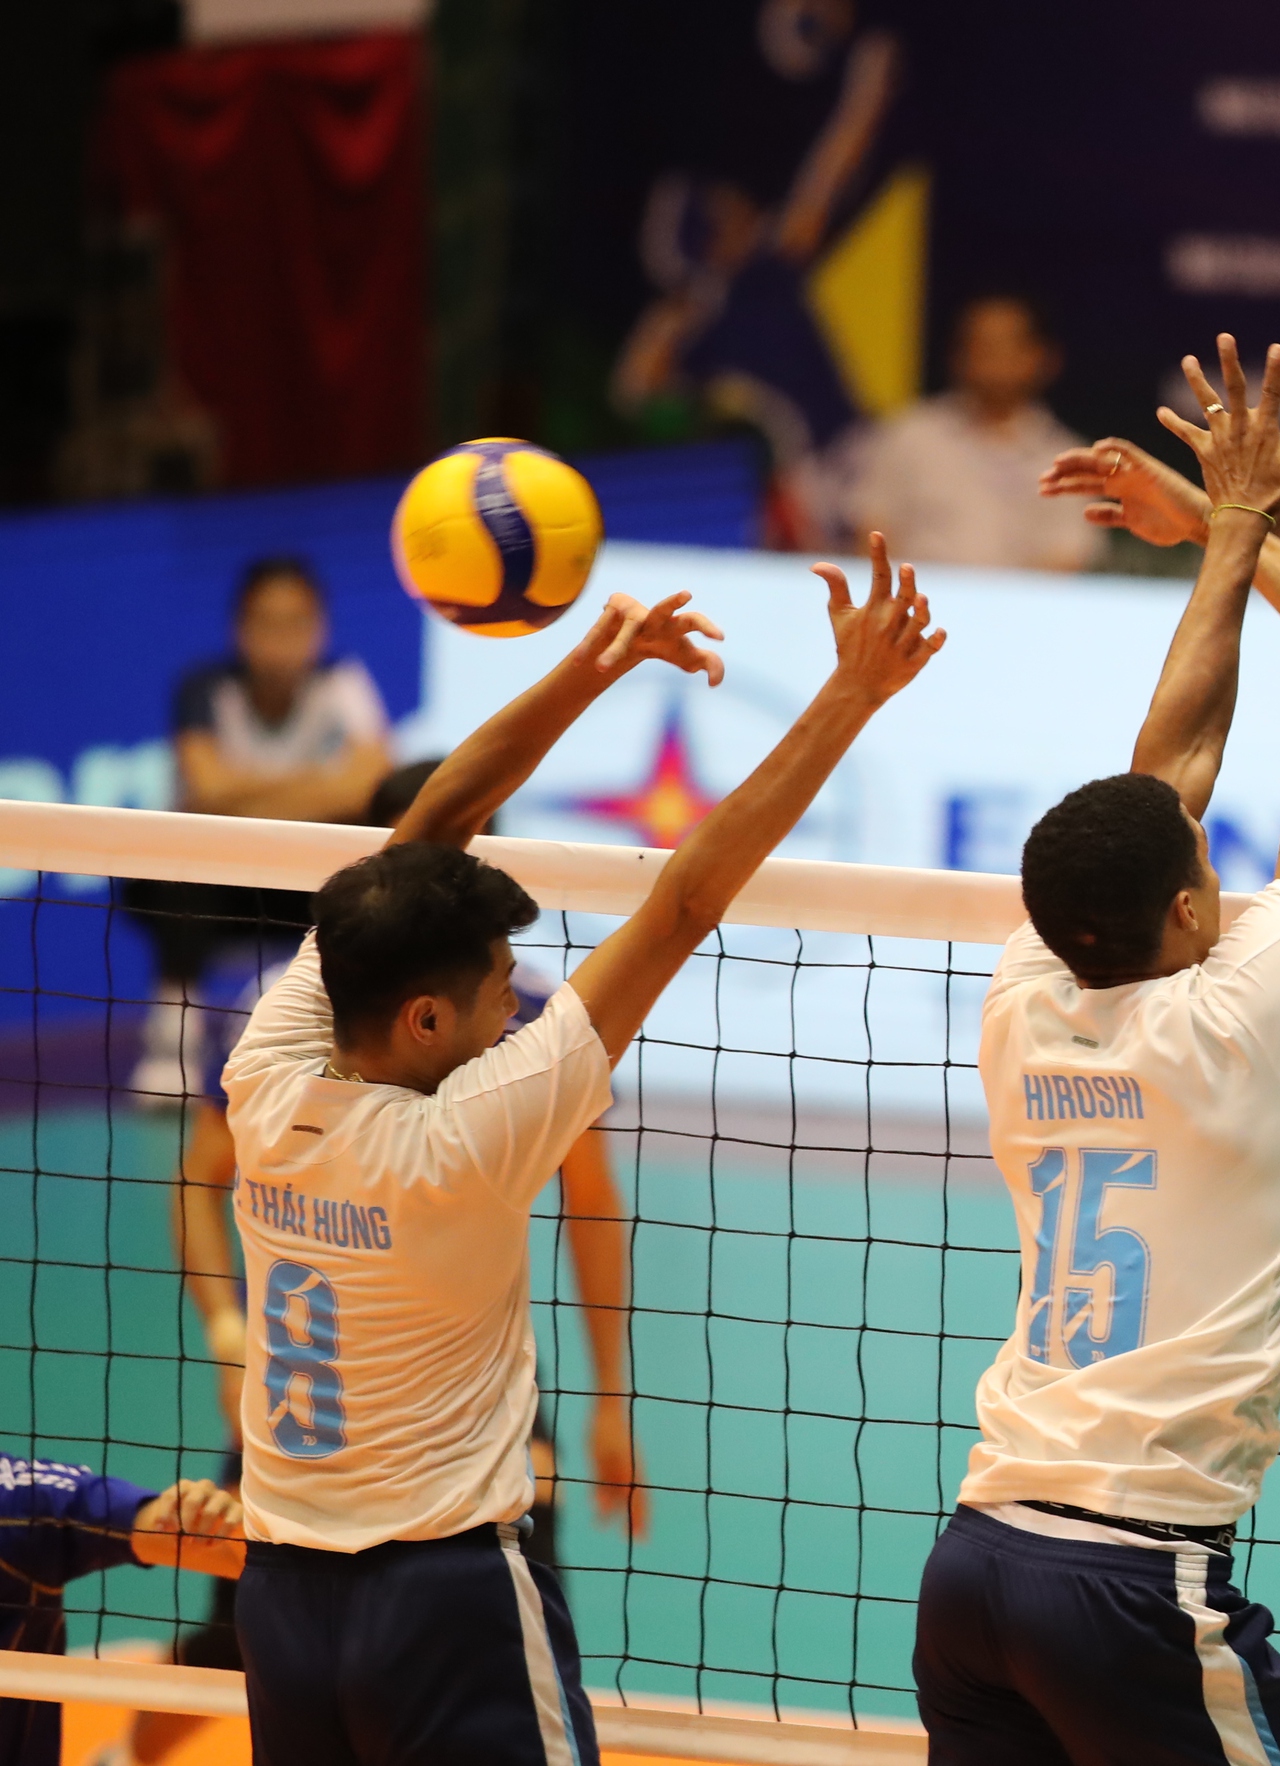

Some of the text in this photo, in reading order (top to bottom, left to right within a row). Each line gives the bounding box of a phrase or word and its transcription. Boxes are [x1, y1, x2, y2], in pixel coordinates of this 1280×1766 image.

[1023, 1074, 1145, 1120] HIROSHI
[245, 1177, 306, 1237] THÁI
[313, 1199, 392, 1250] HƯNG
[1026, 1146, 1157, 1370] 15
[263, 1258, 348, 1459] 8
